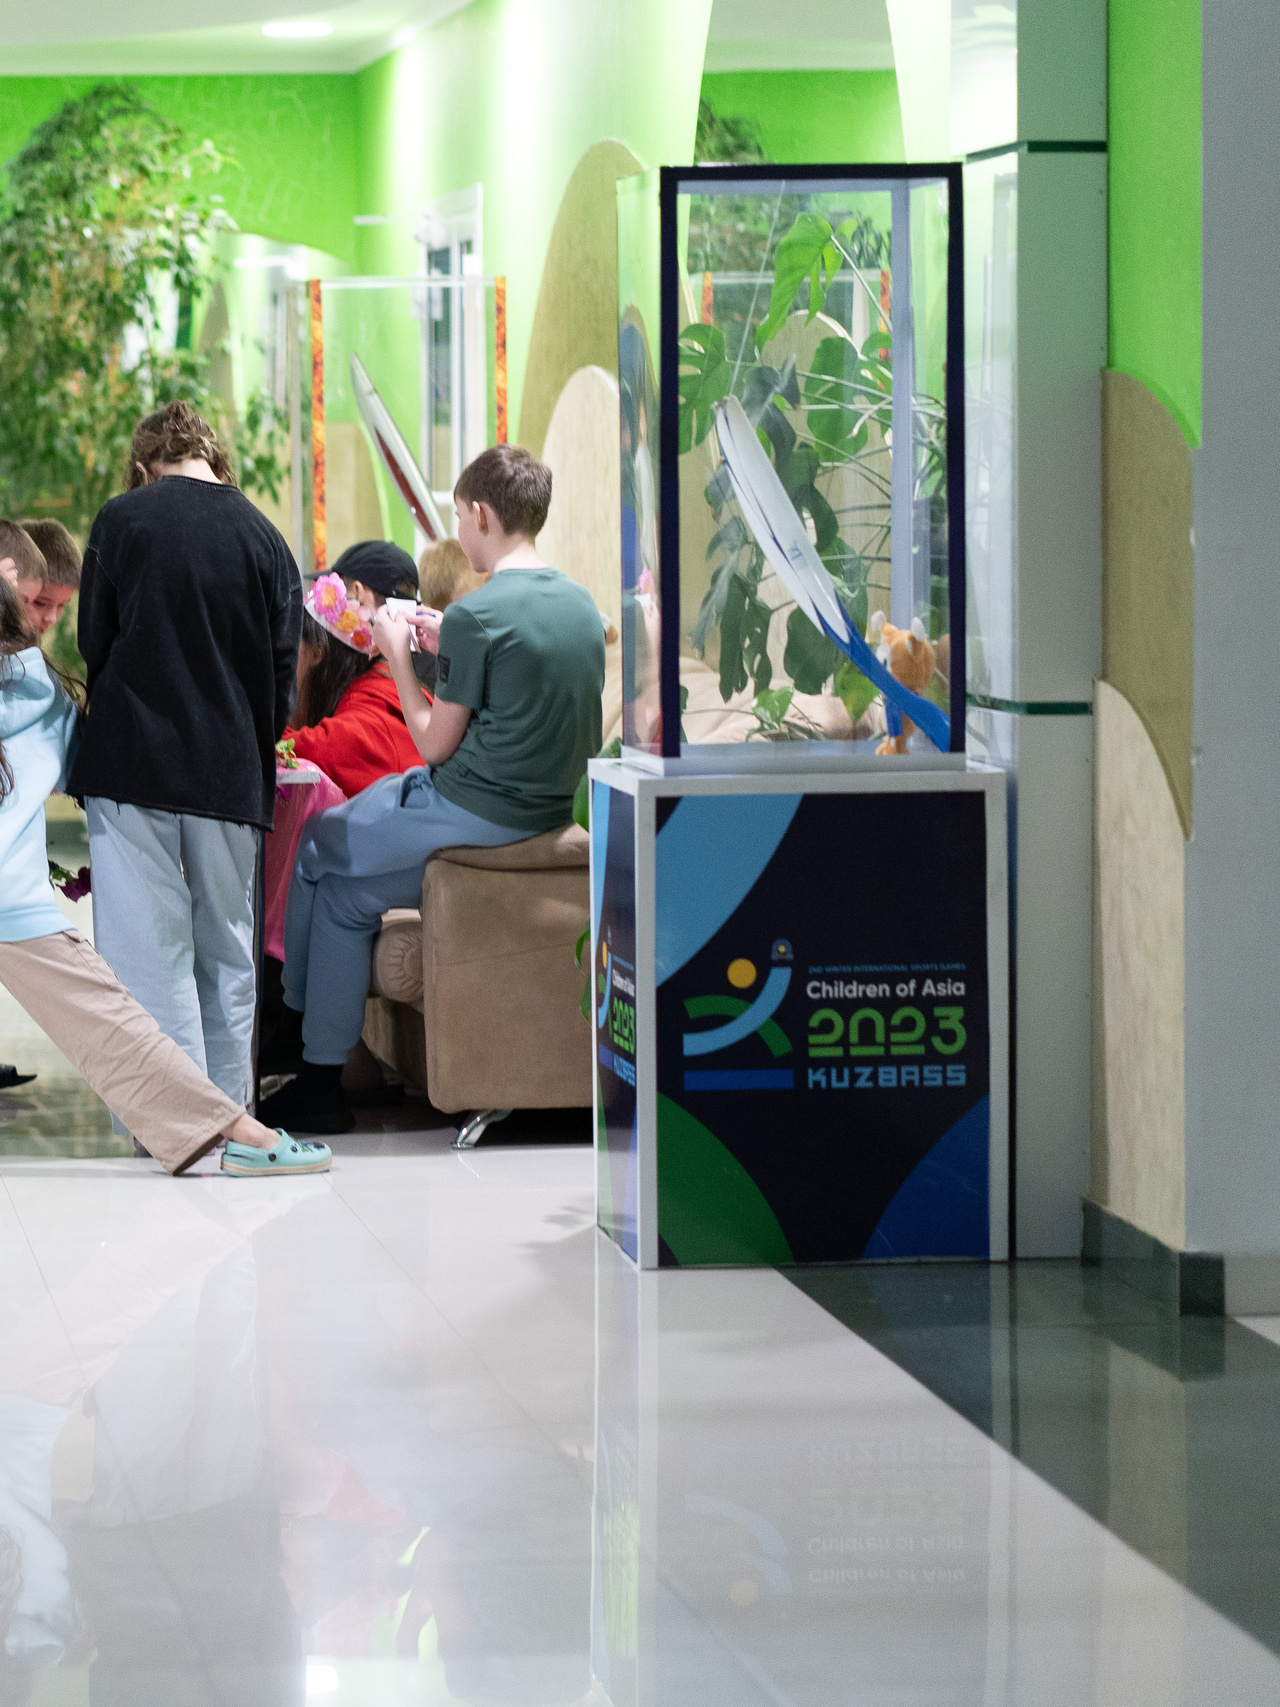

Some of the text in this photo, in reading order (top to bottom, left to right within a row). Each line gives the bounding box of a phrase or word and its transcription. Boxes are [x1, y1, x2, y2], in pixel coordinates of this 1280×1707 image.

[806, 977, 966, 999] Children of Asia
[808, 1006, 967, 1058] 2023
[808, 1064, 967, 1090] KUZBASS
